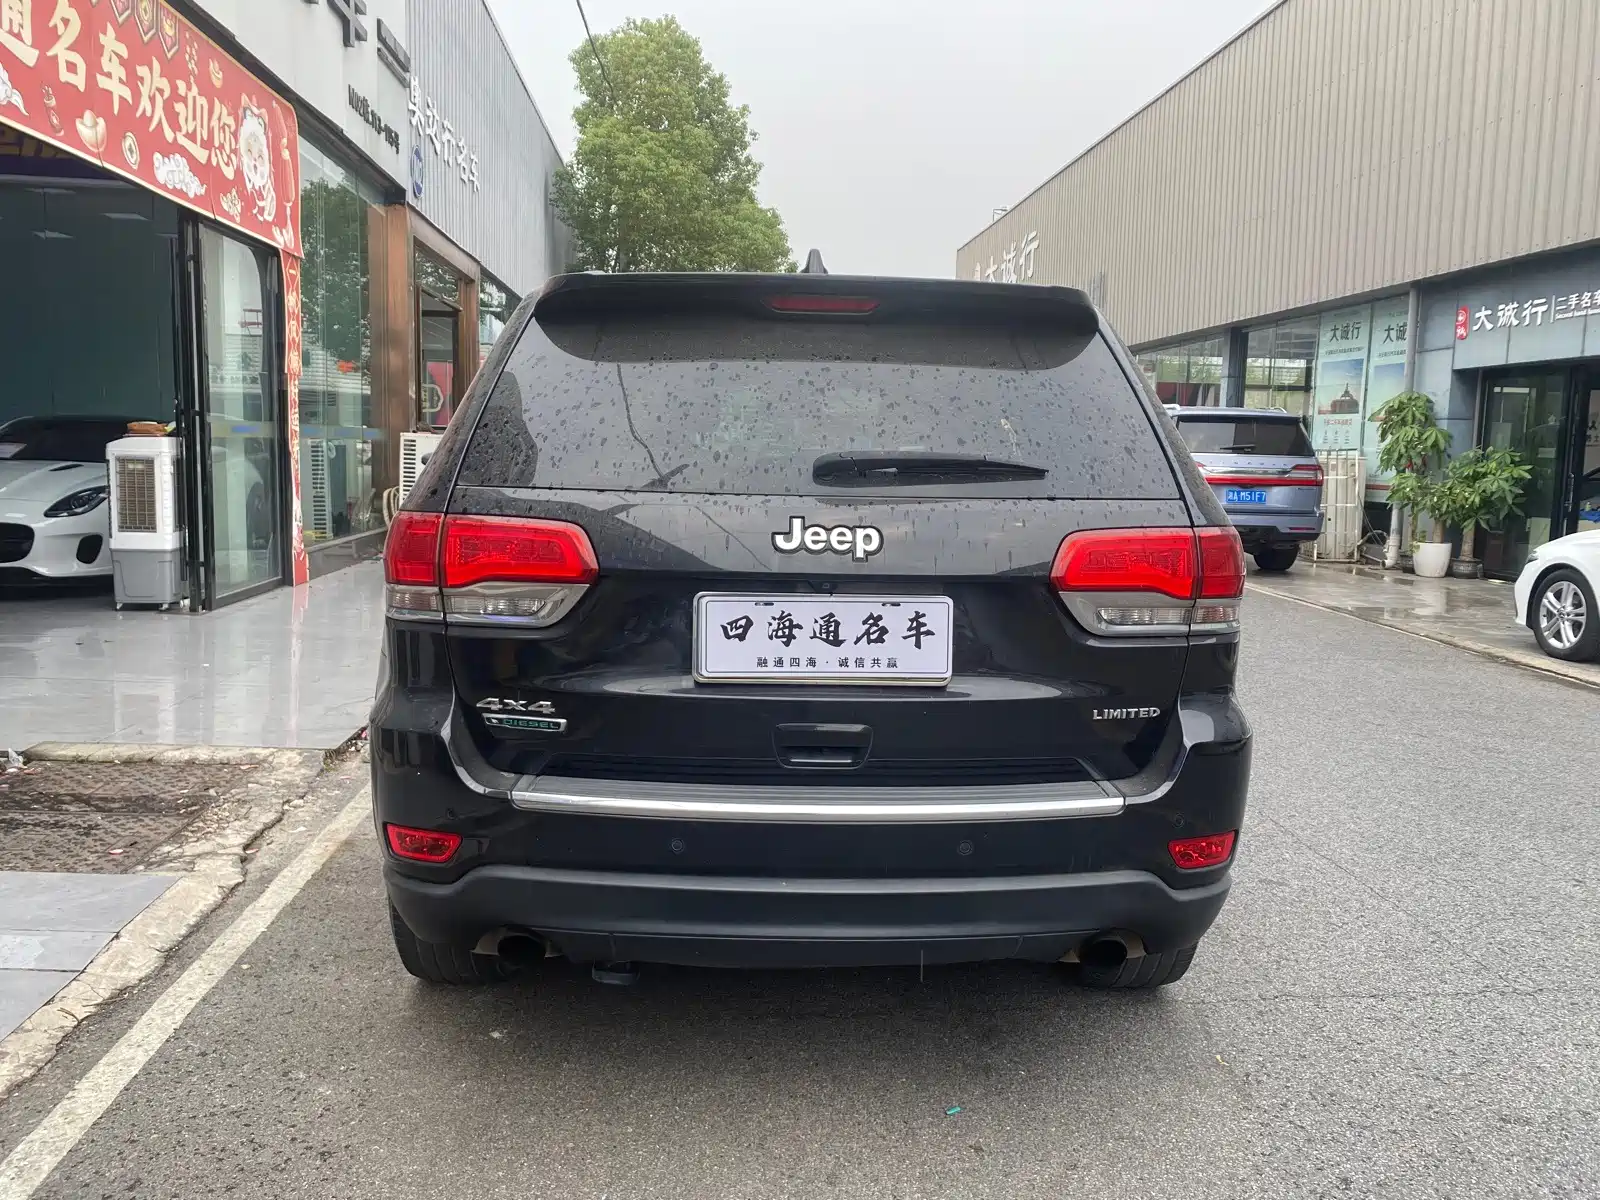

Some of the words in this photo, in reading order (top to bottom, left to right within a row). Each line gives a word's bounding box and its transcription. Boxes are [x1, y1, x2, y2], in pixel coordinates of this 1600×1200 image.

[1472, 298, 1549, 331] 大诚行
[1329, 321, 1362, 342] 大诚行
[772, 516, 884, 562] Jeep
[719, 609, 936, 650] 四海通名车
[756, 656, 899, 669] 融通四海·诚信共赢
[503, 719, 559, 729] DIESEL
[1092, 707, 1161, 720] LIMITED
